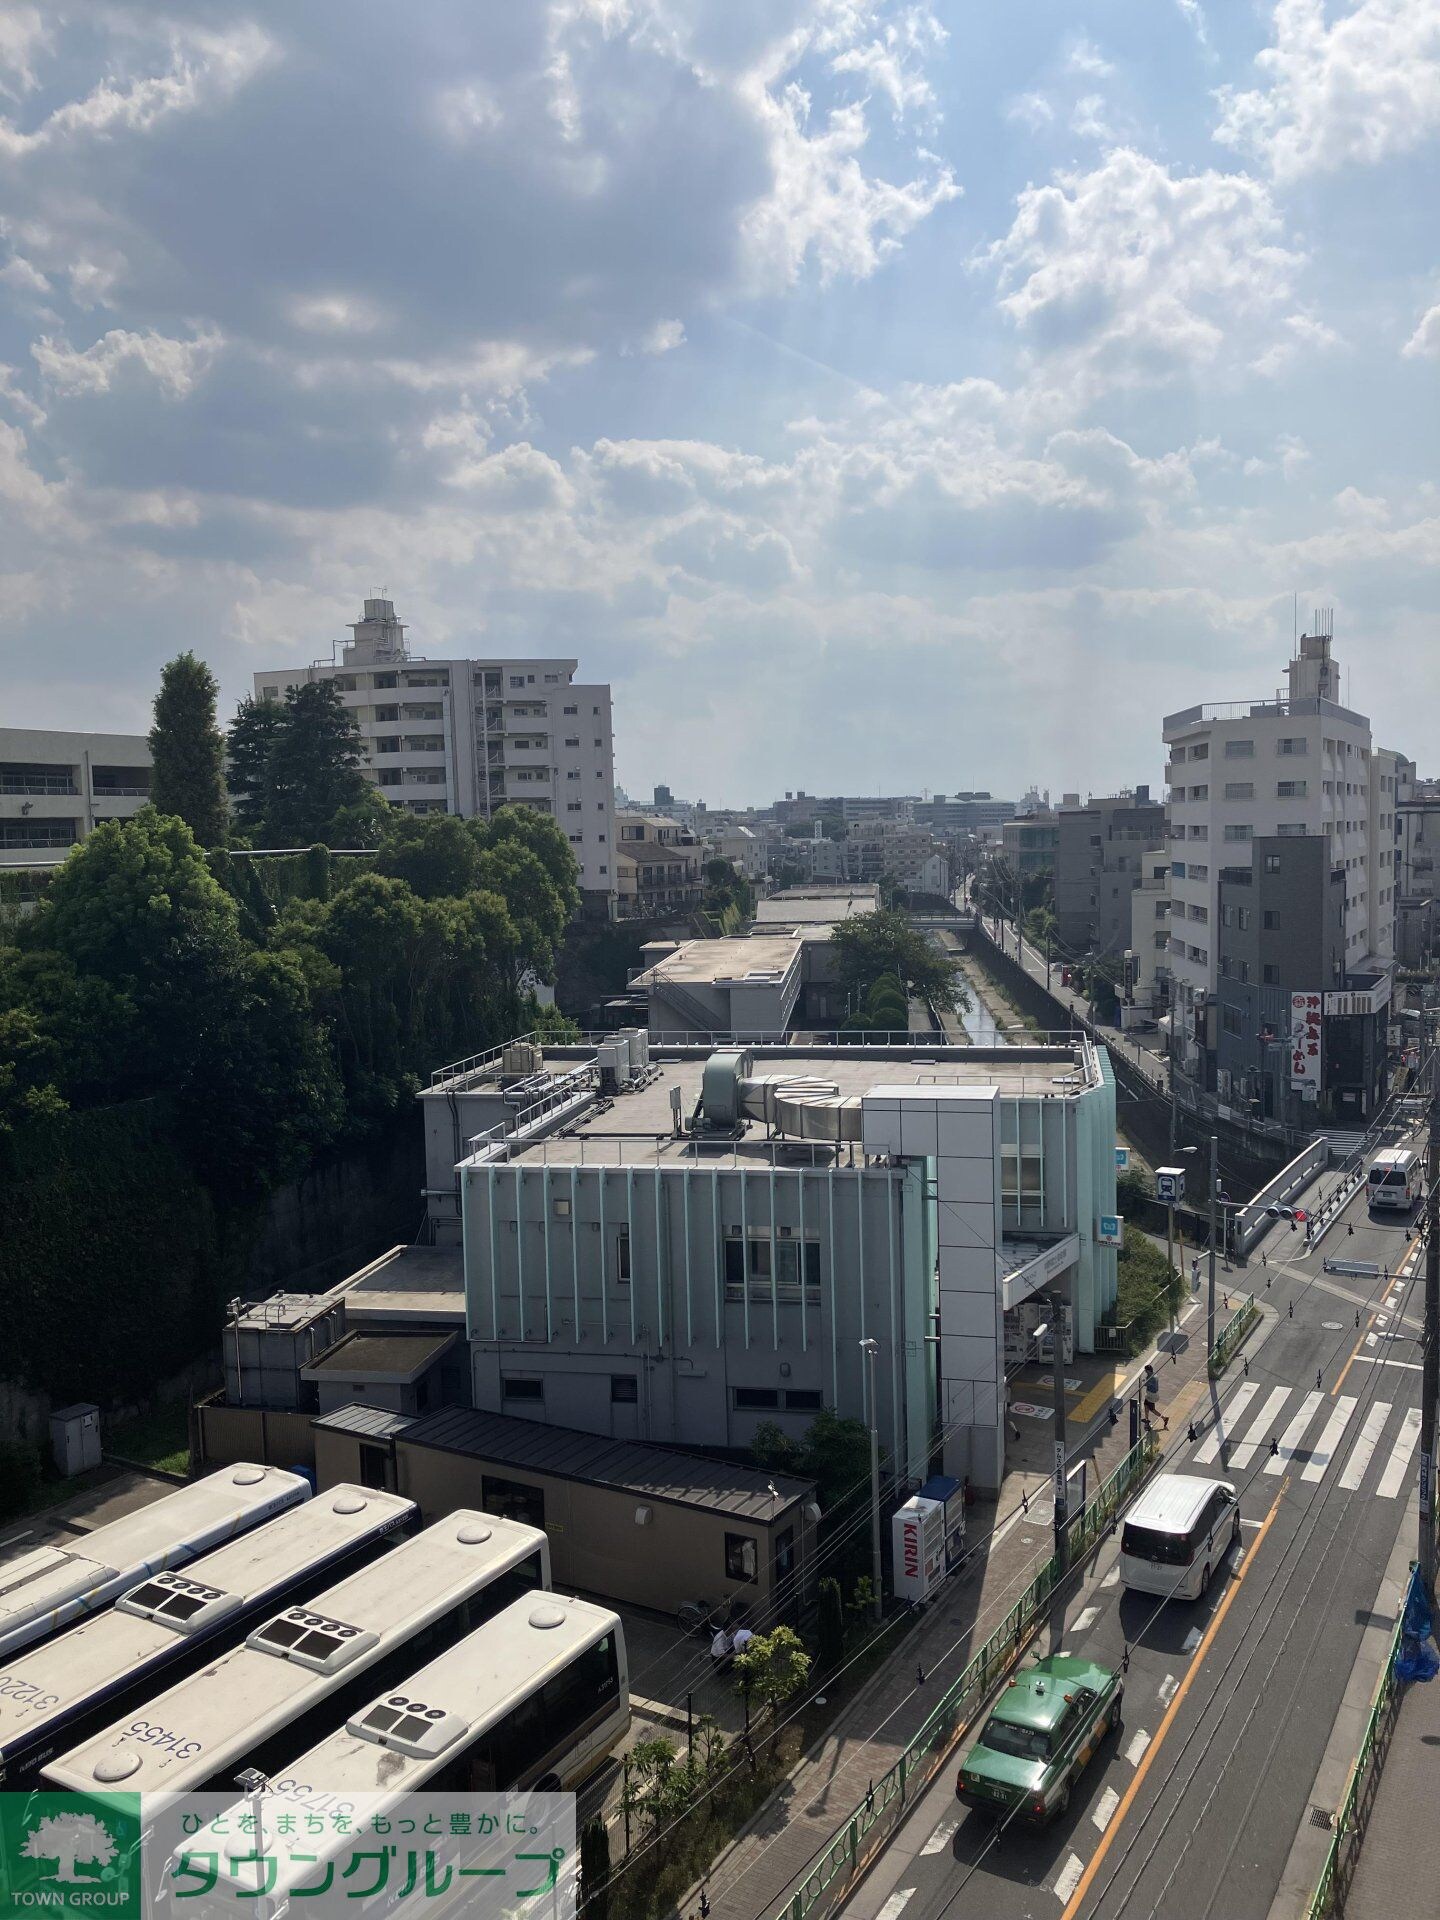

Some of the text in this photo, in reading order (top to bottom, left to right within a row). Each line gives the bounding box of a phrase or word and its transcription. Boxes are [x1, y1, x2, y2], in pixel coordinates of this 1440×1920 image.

[903, 1522, 919, 1578] KIRIN
[122, 1721, 202, 1760] 31455
[277, 1780, 356, 1820] 31755
